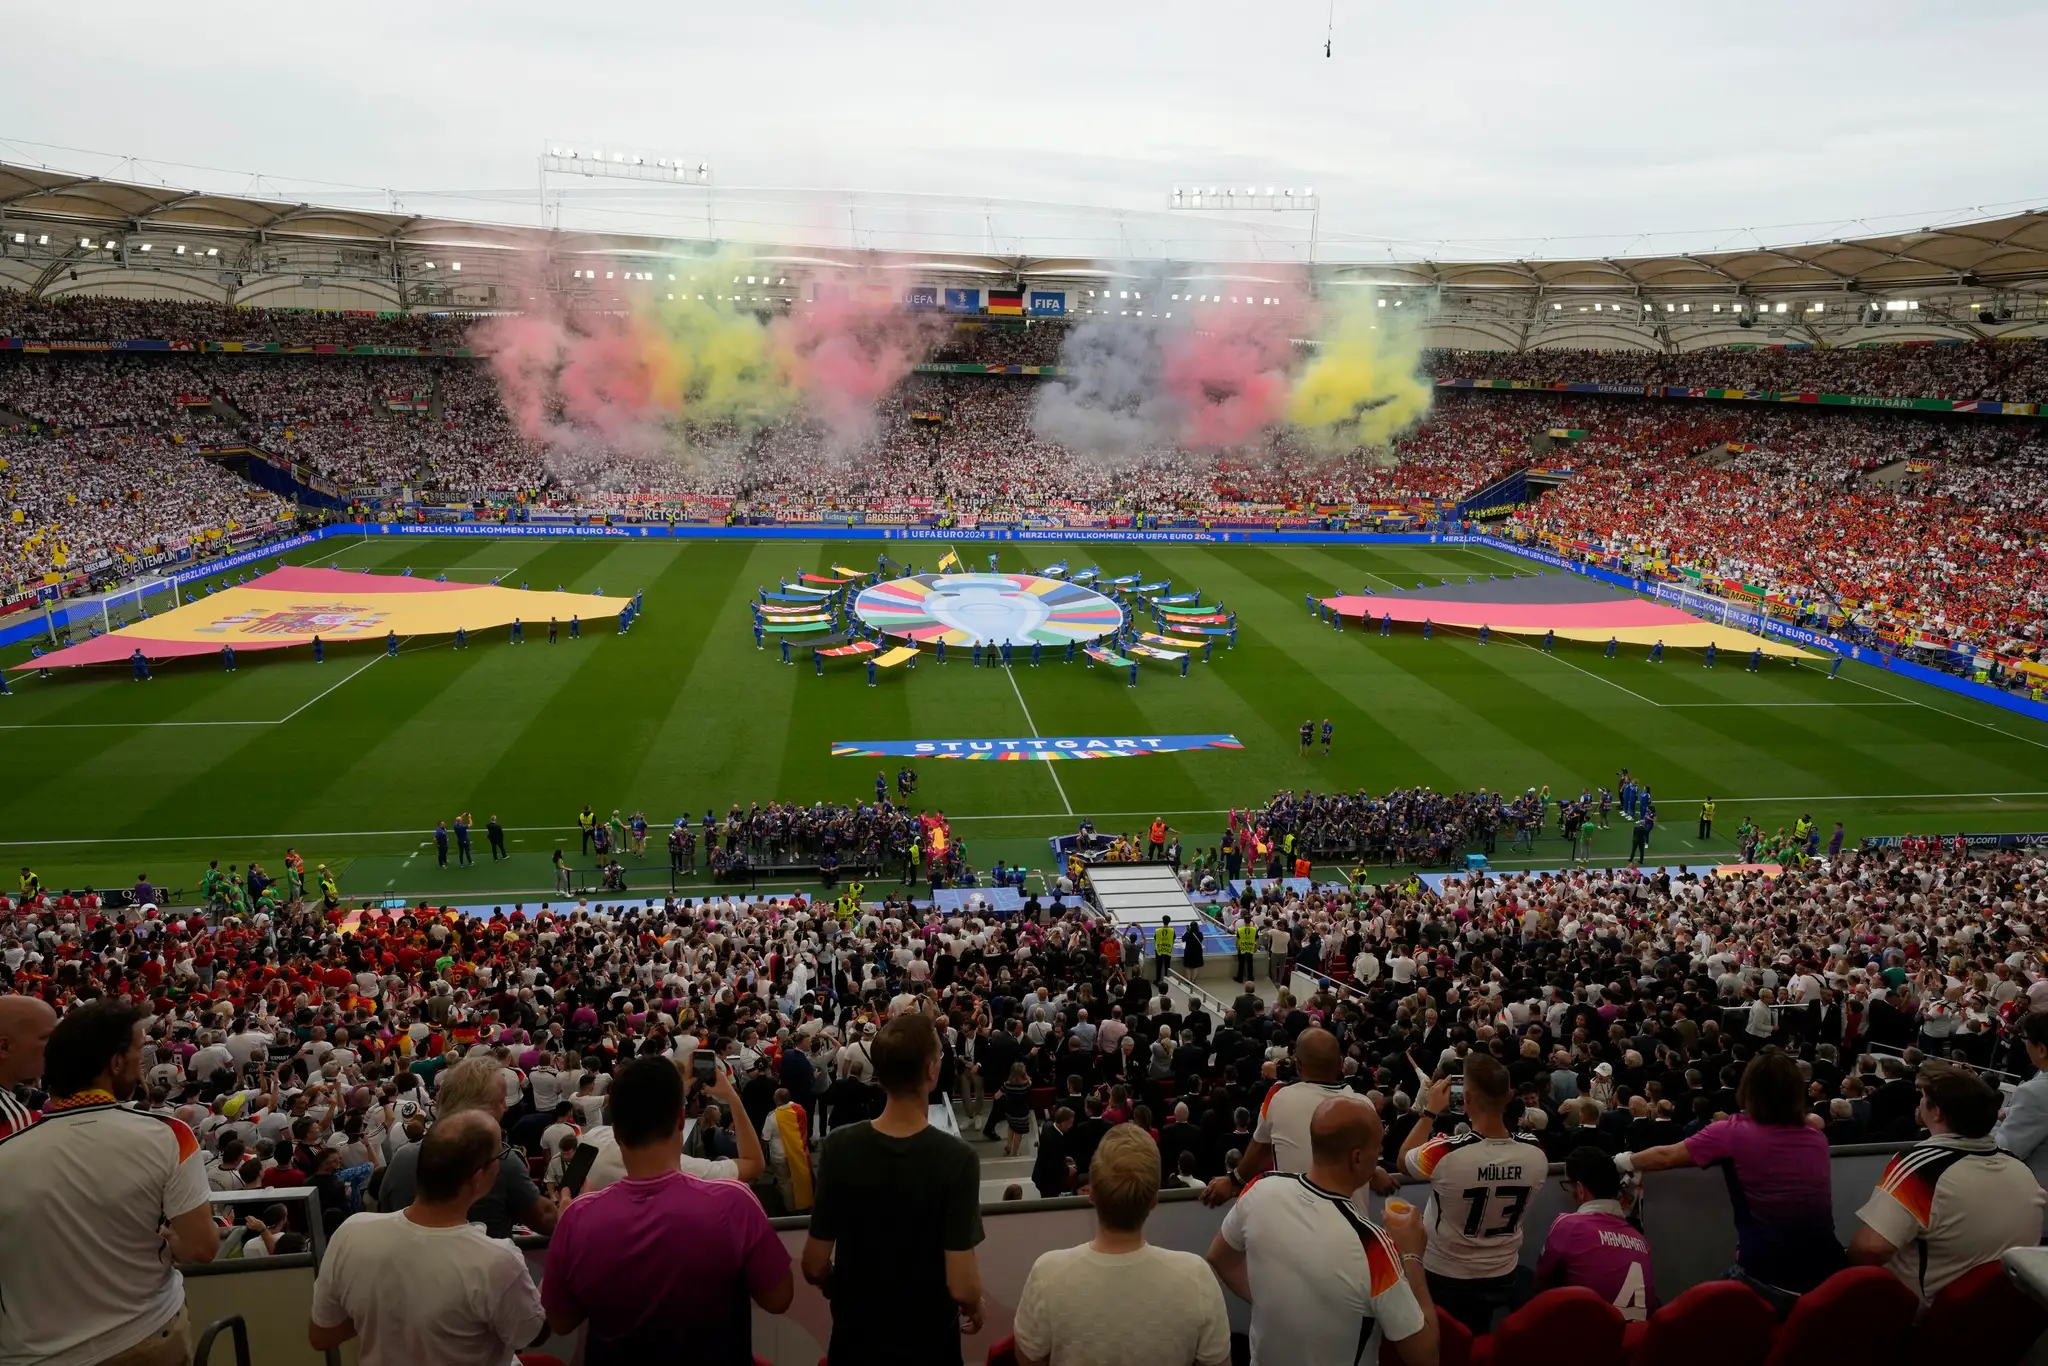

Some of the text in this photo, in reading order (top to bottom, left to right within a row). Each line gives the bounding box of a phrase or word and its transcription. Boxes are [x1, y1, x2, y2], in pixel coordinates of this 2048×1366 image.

[905, 293, 934, 304] UEFA
[1035, 298, 1061, 309] FIFA
[351, 488, 376, 498] HALLE
[429, 492, 461, 502] SPENGE
[645, 509, 688, 521] KETSCH
[776, 511, 824, 521] GOLTERN
[401, 524, 453, 534] HERZLICH
[453, 525, 525, 535] WILLKOMMEN
[548, 527, 575, 535] UEFA
[576, 527, 603, 535] EURO
[1019, 530, 1064, 539] HERZLICH
[1064, 532, 1125, 540] WILLKOMMEN
[1442, 535, 1482, 543] HERZLICH
[1482, 537, 1518, 553] WILLKOMMEN
[1517, 547, 1530, 557] ZUR
[1529, 551, 1545, 561] UEFA
[1544, 555, 1561, 566] EURO
[143, 550, 176, 568] TEMPLIN
[176, 565, 211, 583] HERZLICH
[212, 554, 257, 571] WILLKOMMEN
[257, 547, 270, 557] ZUR
[270, 543, 285, 553] UEFA
[285, 538, 301, 548] EURO
[6, 589, 37, 605] BRETTEN
[1684, 596, 1739, 621] WILLKOMMEN
[1739, 612, 1759, 628] ZUR
[1760, 617, 1784, 635] UEFA
[1785, 627, 1813, 643] EURO
[915, 738, 1161, 752] STUTTGART
[1477, 1165, 1522, 1182] MÜLLER
[1462, 1185, 1532, 1238] 13
[1612, 1261, 1648, 1321] 4
